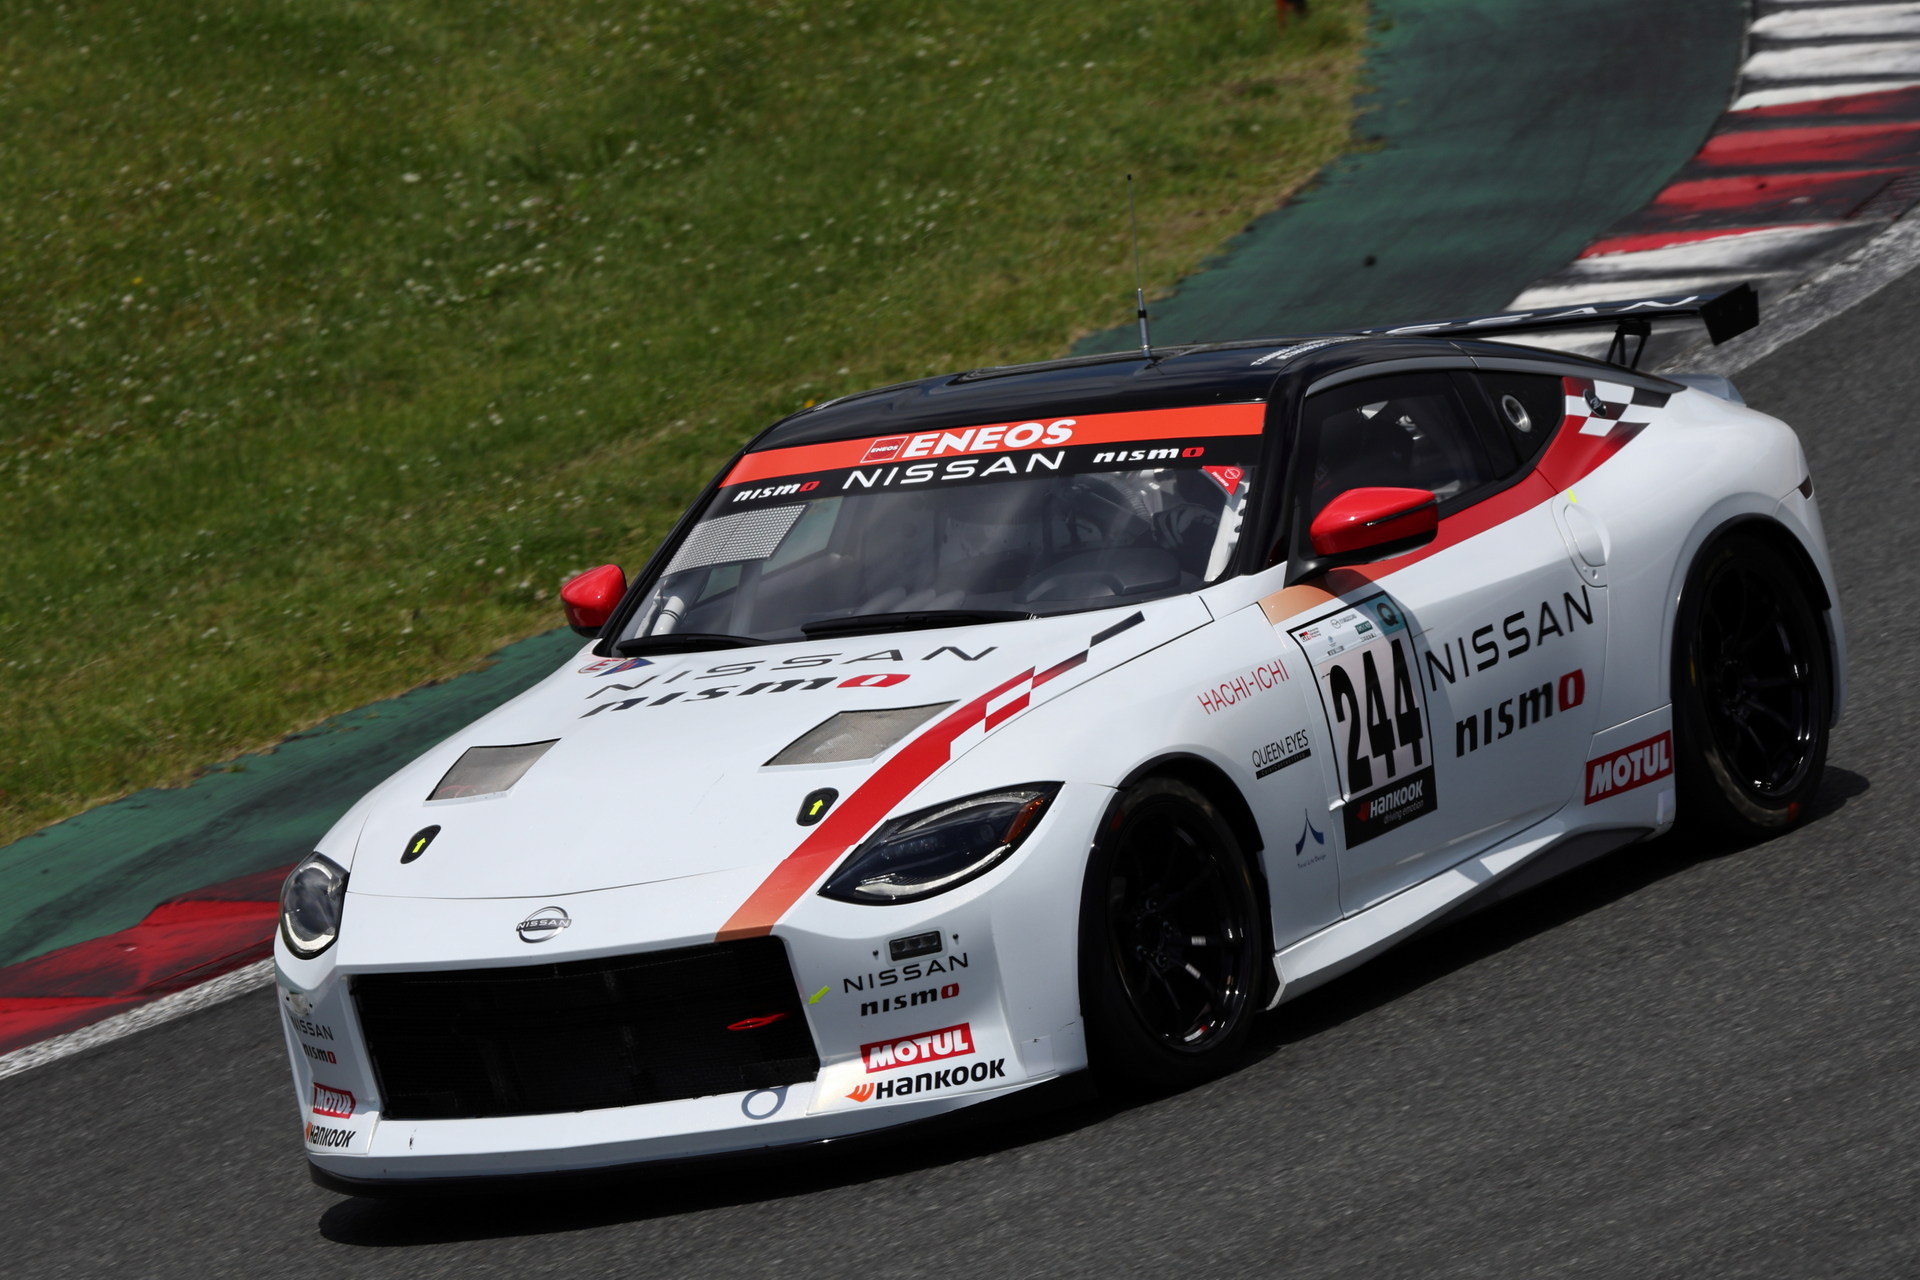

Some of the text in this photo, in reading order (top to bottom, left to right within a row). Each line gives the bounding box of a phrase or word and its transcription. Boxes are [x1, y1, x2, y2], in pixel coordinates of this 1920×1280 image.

[902, 419, 1077, 458] ENEOS
[1093, 446, 1204, 463] nismo
[842, 451, 1065, 490] NISSAN
[733, 480, 819, 502] nismo
[1377, 602, 1399, 626] Q
[1425, 584, 1593, 692] NISSAN
[584, 646, 998, 699] NISSAN
[1197, 659, 1289, 715] HACHI-ICHI
[578, 673, 911, 719] nismo
[1455, 668, 1585, 758] nismo
[1329, 638, 1424, 795] 244
[1252, 729, 1309, 768] QUEEN EYES
[1588, 737, 1671, 799] MOTUL
[516, 917, 571, 931] NISSAN
[843, 952, 969, 993] NISSAN
[861, 983, 960, 1016] nismo
[291, 1015, 334, 1041] NISSAN
[302, 1042, 337, 1065] nismo
[868, 1029, 969, 1069] MOTUL
[315, 1086, 353, 1114] MOTUL
